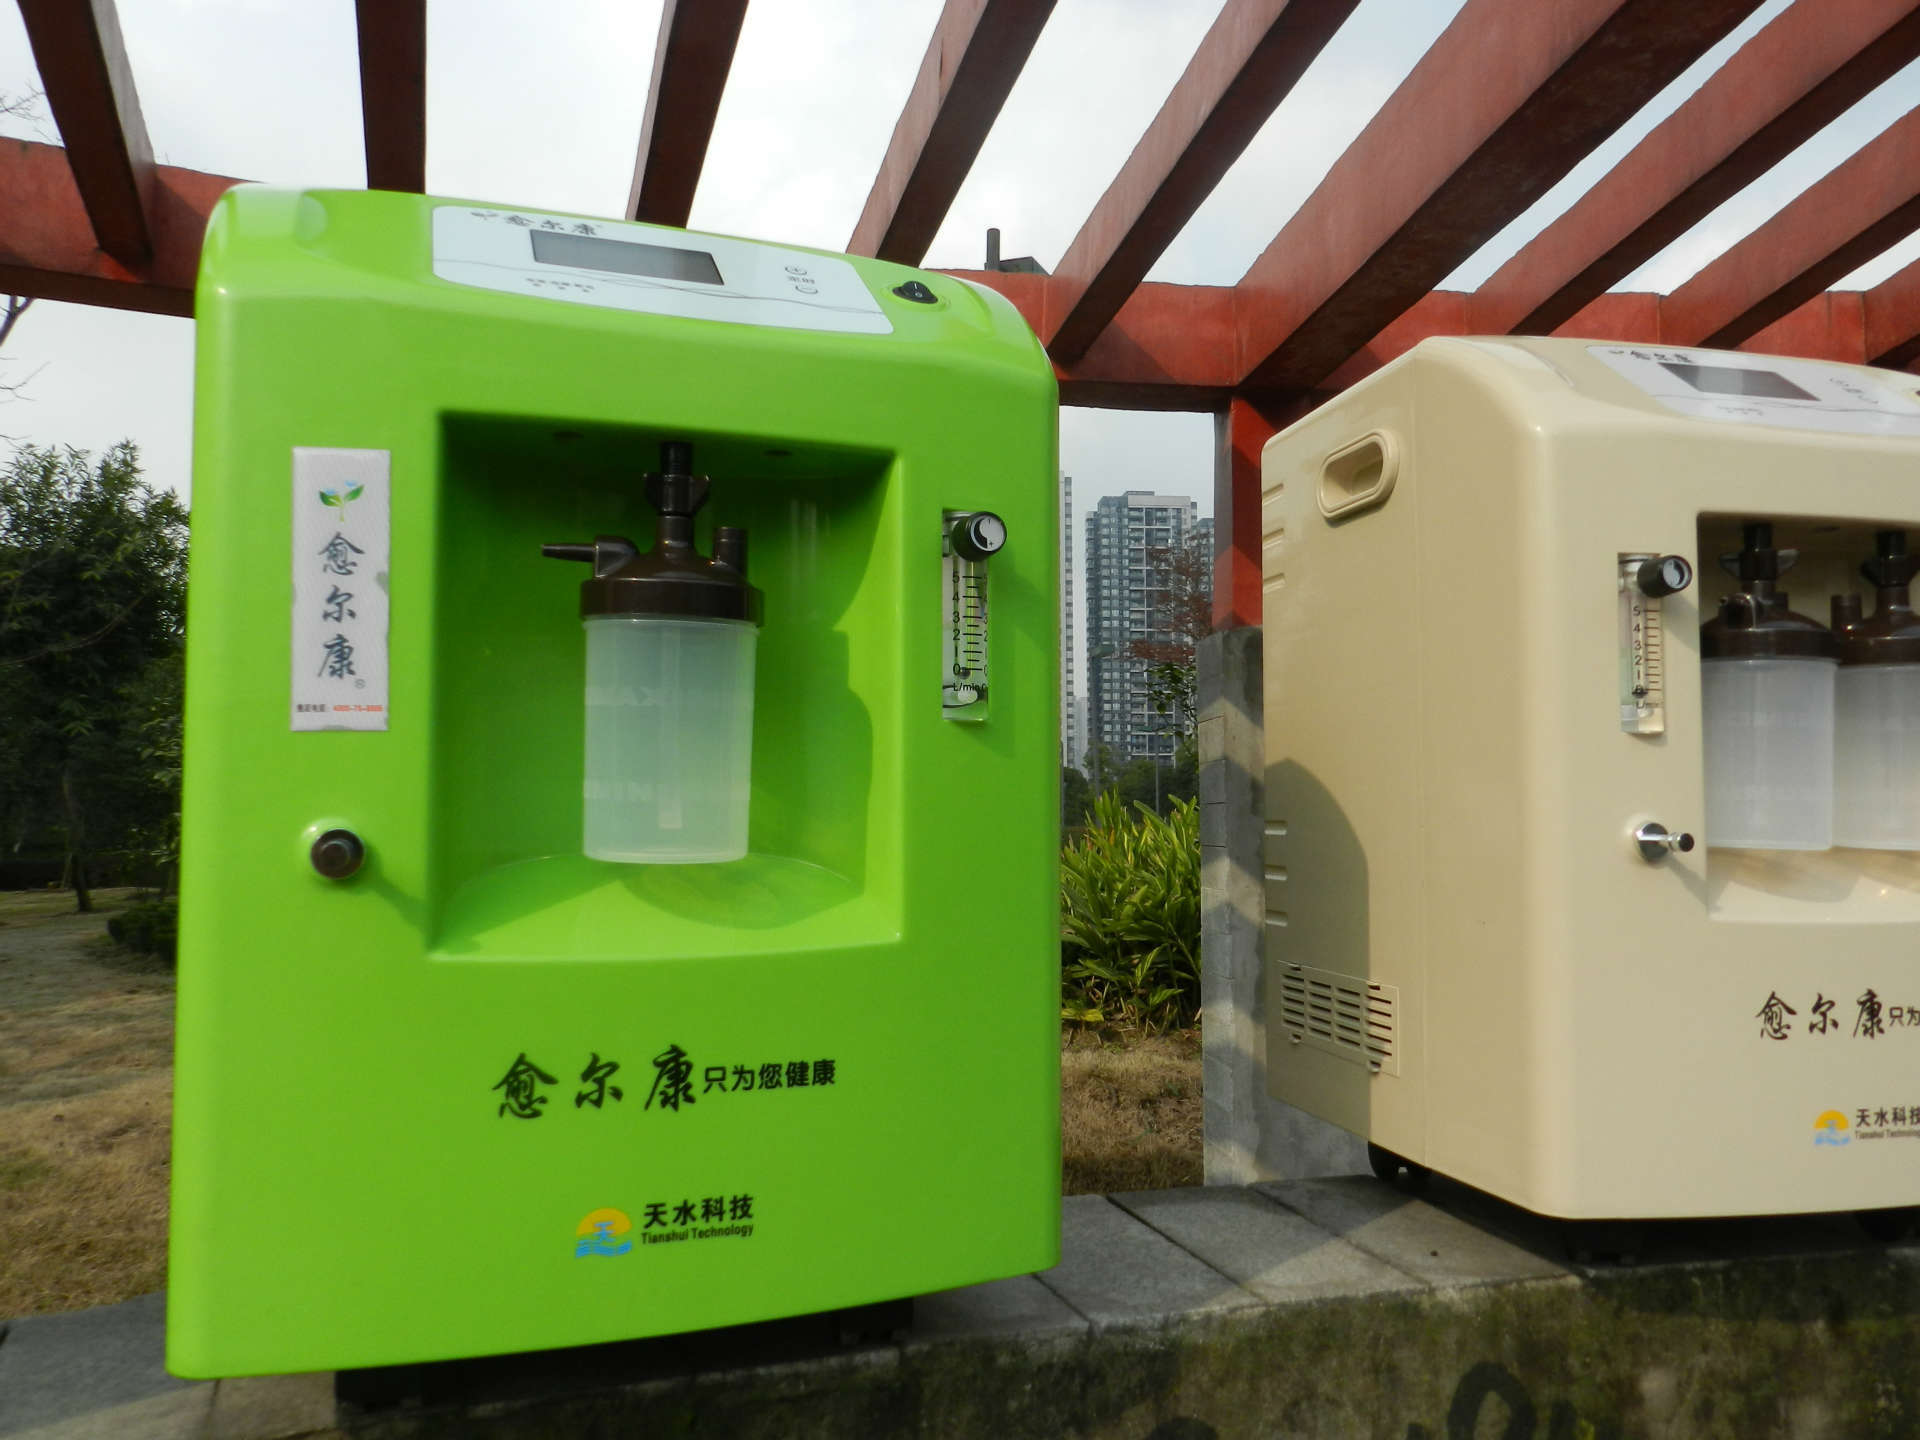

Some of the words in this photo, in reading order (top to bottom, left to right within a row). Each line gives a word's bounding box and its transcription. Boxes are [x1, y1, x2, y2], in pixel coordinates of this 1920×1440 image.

[318, 531, 365, 680] 愈尔康
[952, 591, 960, 603] 4
[952, 610, 960, 624] 3
[952, 628, 960, 641] 2
[952, 663, 960, 676] 0
[1755, 988, 1885, 1040] 愈尔康
[491, 1043, 696, 1120] 愈尔康
[703, 1058, 837, 1094] 只为您健康
[643, 1193, 754, 1230] 天水科技
[641, 1227, 689, 1245] Tianshui
[692, 1223, 754, 1240] Technology
